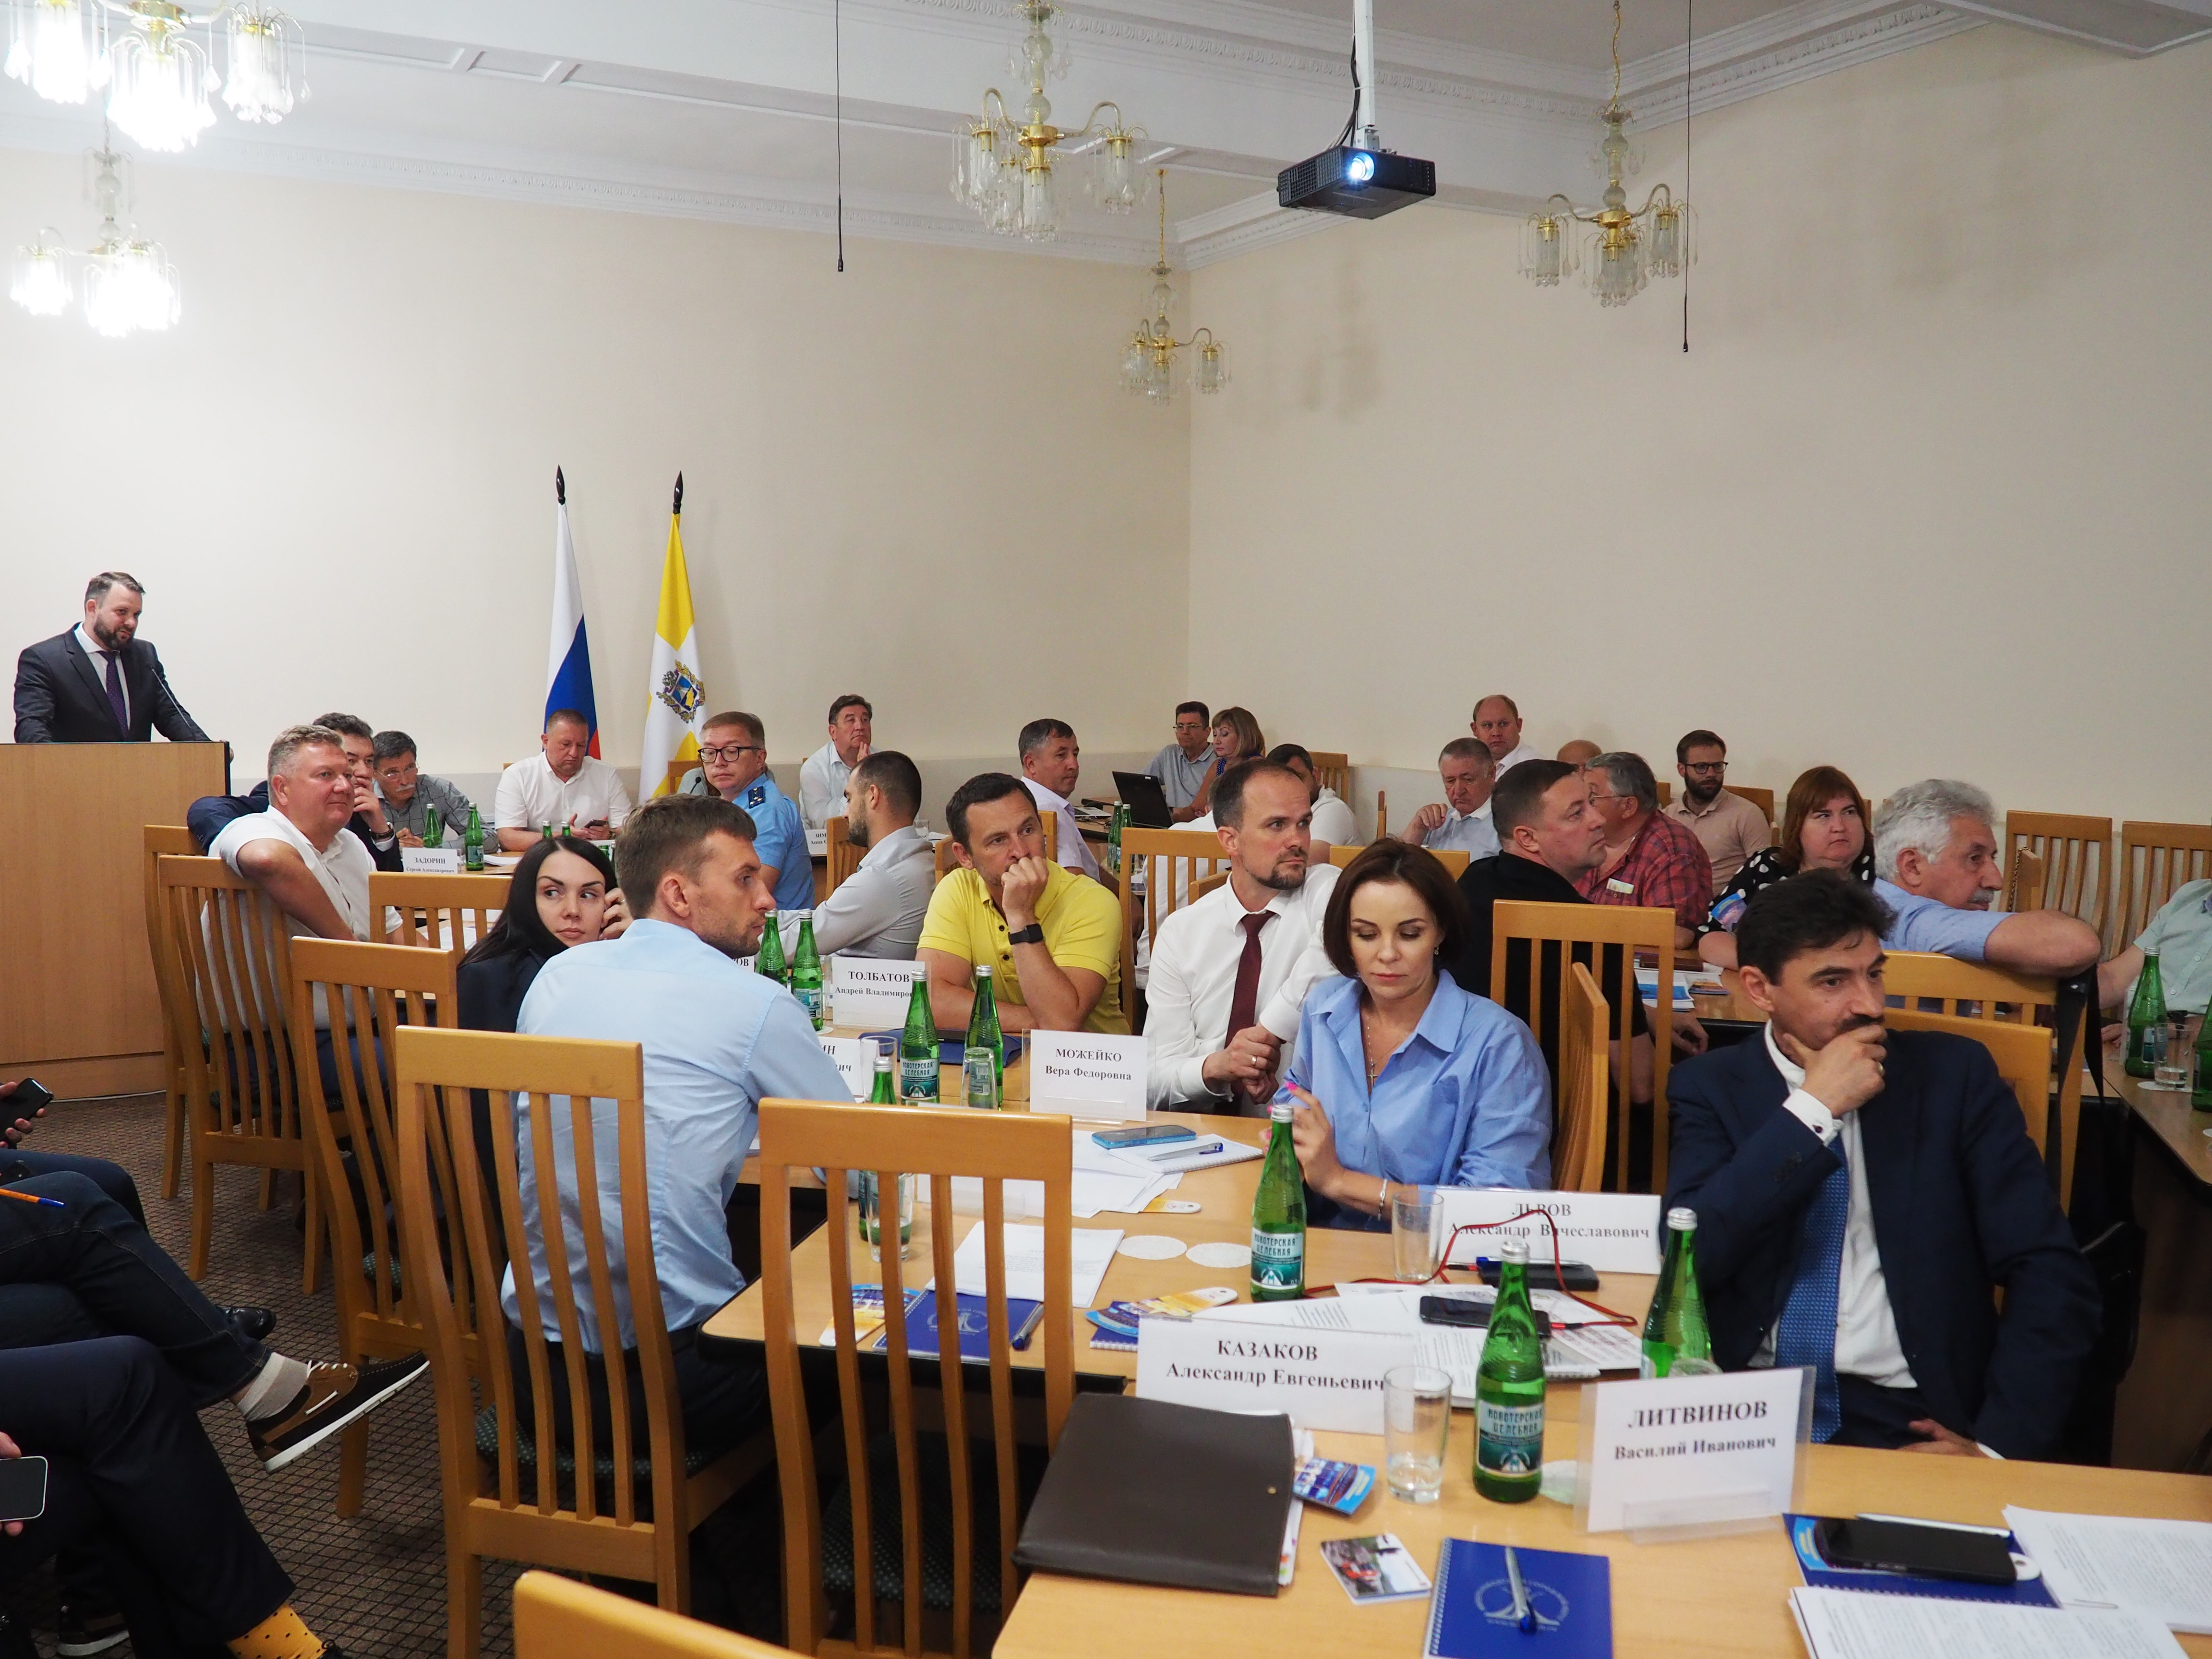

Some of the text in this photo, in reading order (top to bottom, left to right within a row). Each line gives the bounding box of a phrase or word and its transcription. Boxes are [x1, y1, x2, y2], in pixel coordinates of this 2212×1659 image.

[733, 958, 749, 966] ОВ
[848, 971, 910, 983] ТОЛБАТОВ
[835, 986, 863, 996] Андрей
[1056, 1048, 1122, 1062] МОЖЕЙКО
[1046, 1065, 1131, 1081] Вера Федоровна
[1257, 1244, 1291, 1256] ЦЕЛЕБНАЯ
[1217, 1340, 1318, 1361] КАЗАКОВ
[1166, 1362, 1385, 1391] Александр Евгеньевич
[1627, 1400, 1767, 1429] ЛИТВИНОВ
[1614, 1438, 1776, 1460] Василий Иванович
